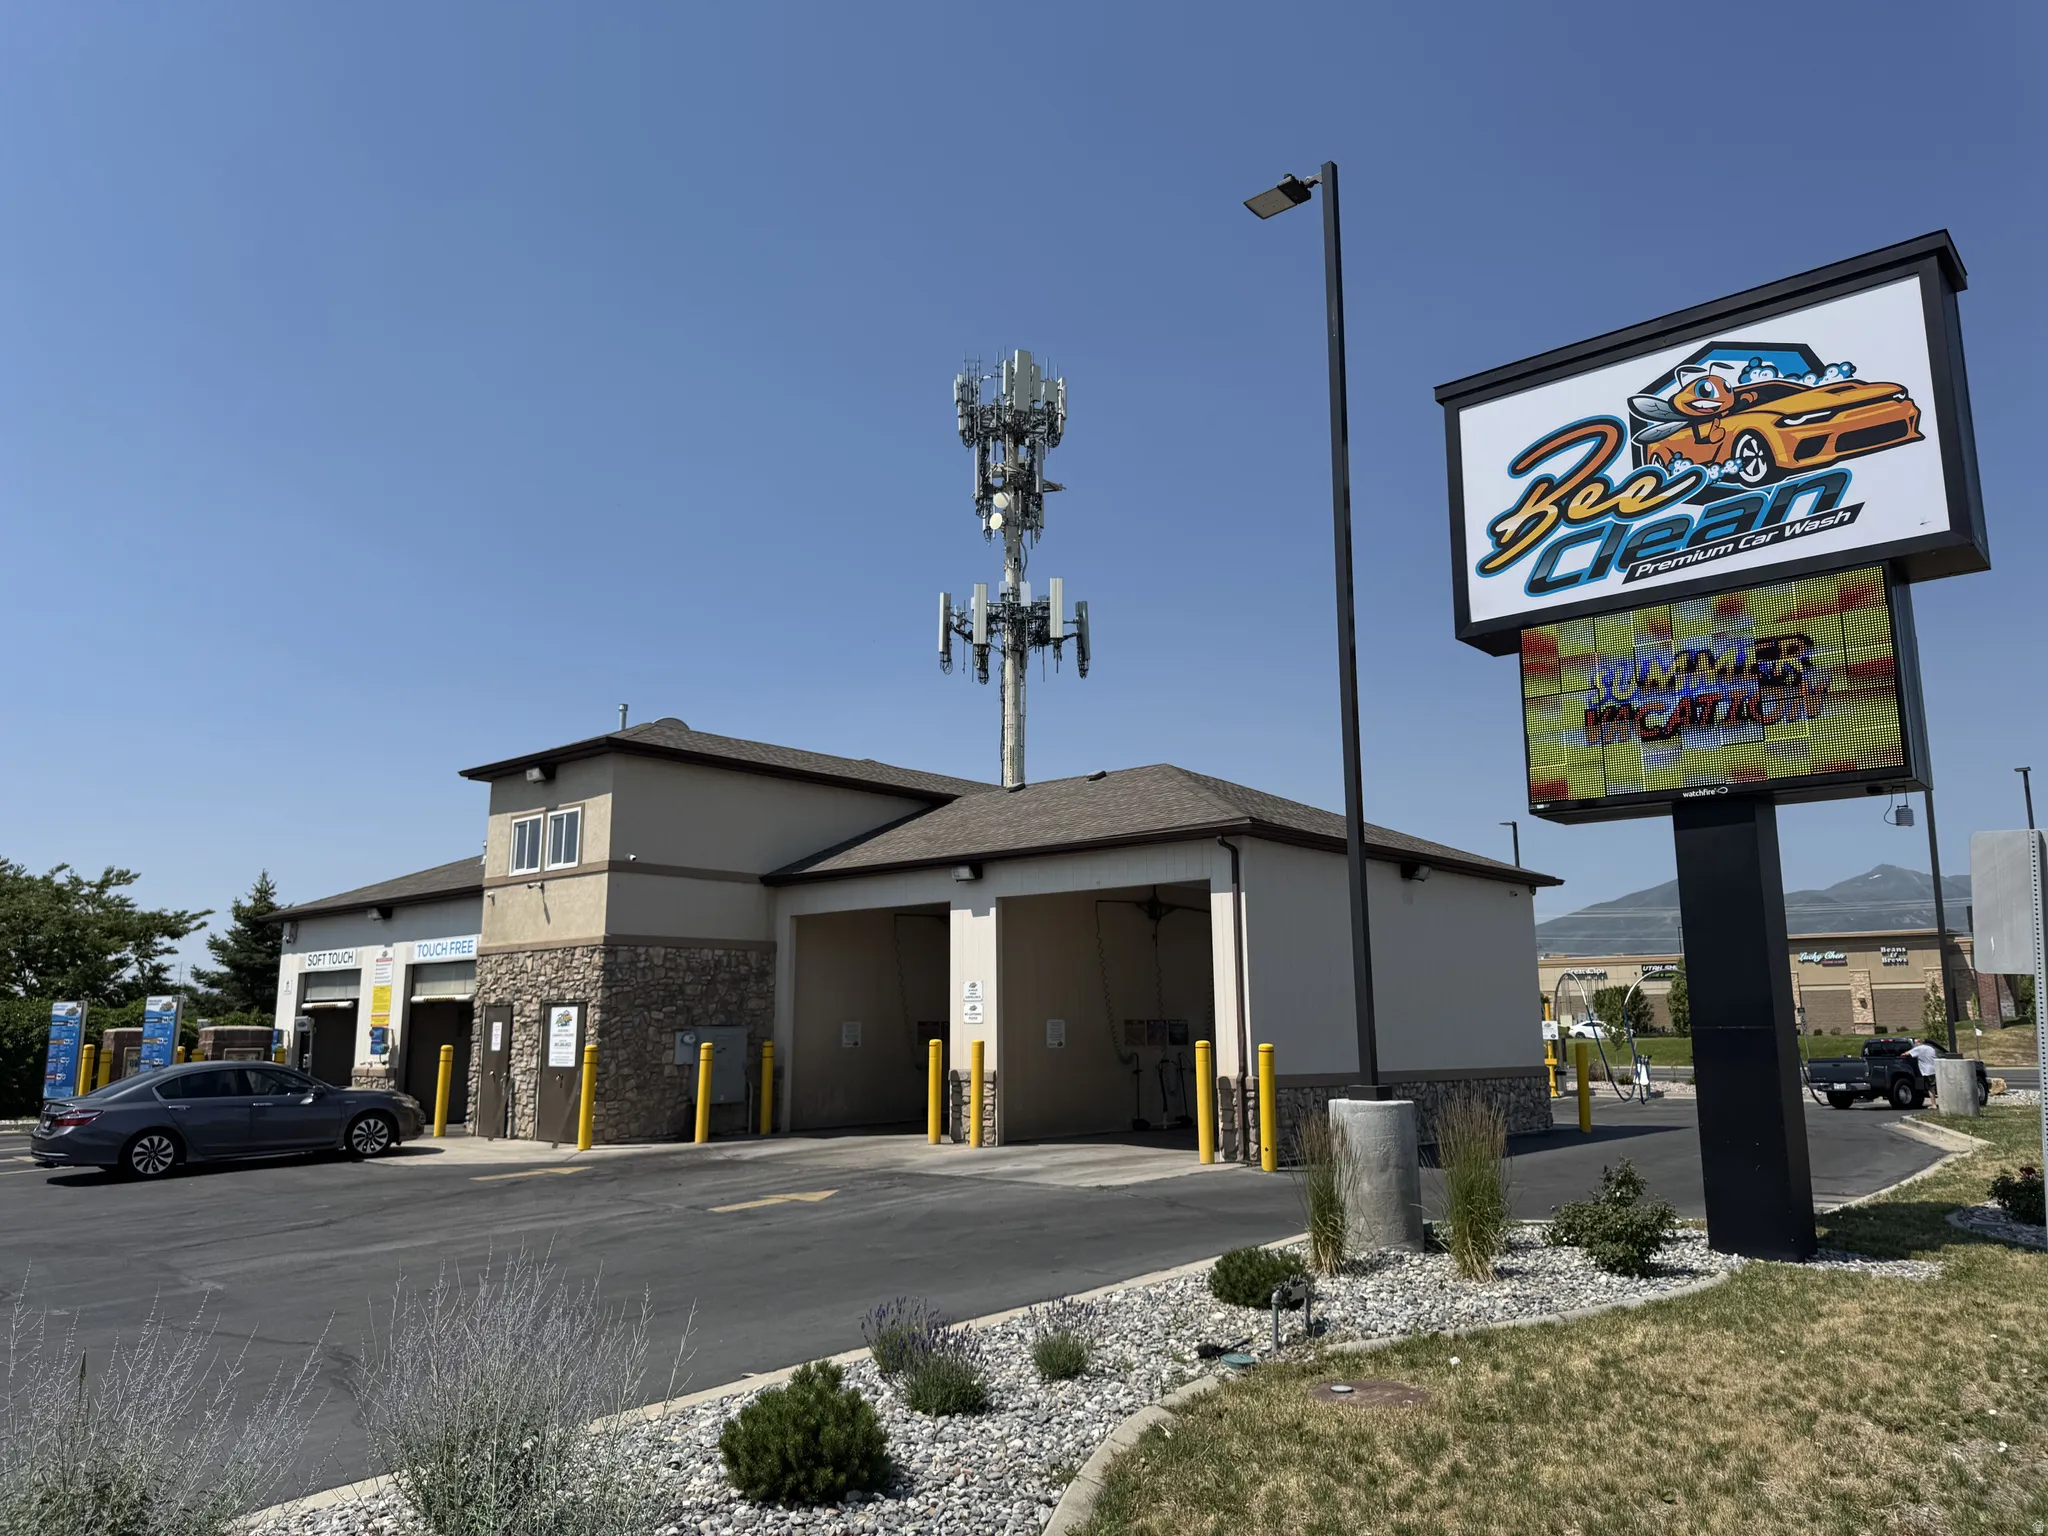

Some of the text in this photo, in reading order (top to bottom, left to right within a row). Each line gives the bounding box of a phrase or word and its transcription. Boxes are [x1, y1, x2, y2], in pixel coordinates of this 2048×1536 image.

[1479, 418, 1704, 575] Bee
[1635, 510, 1852, 578] Premium Car Wash
[1590, 634, 1814, 704] SUMMER
[1585, 674, 1831, 745] VACATION
[1683, 788, 1716, 798] watchfire
[417, 940, 474, 957] TOUCH FREE
[1799, 952, 1823, 962] Lucky
[307, 951, 354, 967] SOFT TOUCH
[1564, 967, 1606, 975] Great Clips
